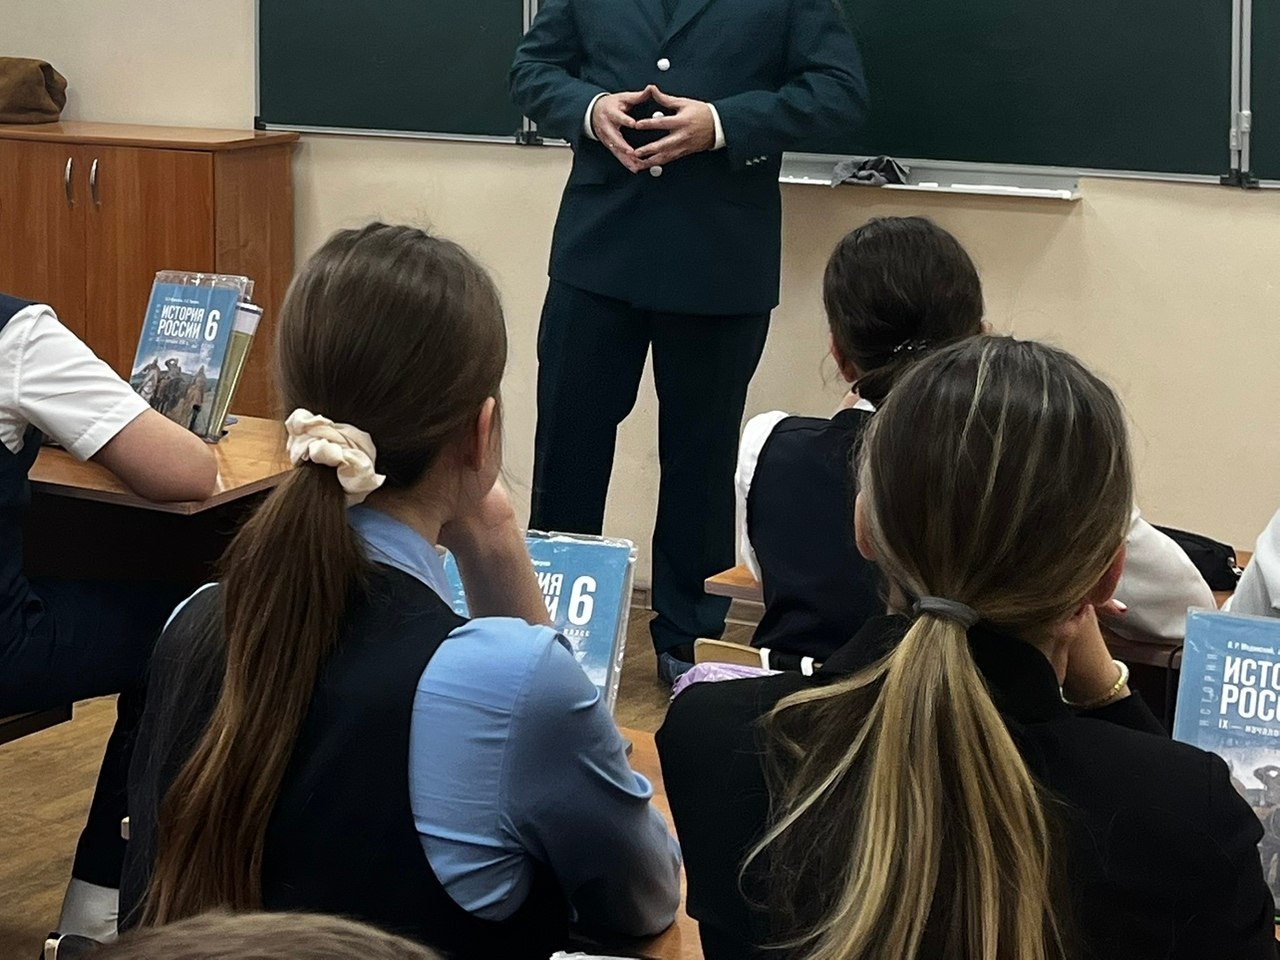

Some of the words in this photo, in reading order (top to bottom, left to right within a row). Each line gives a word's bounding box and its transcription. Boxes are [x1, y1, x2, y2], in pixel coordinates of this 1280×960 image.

[161, 304, 205, 322] ИСТОРИЯ
[204, 309, 221, 341] 6
[157, 318, 201, 339] РОССИИ
[568, 575, 597, 626] 6
[1220, 683, 1280, 722] РОС
[1218, 718, 1229, 730] IX
